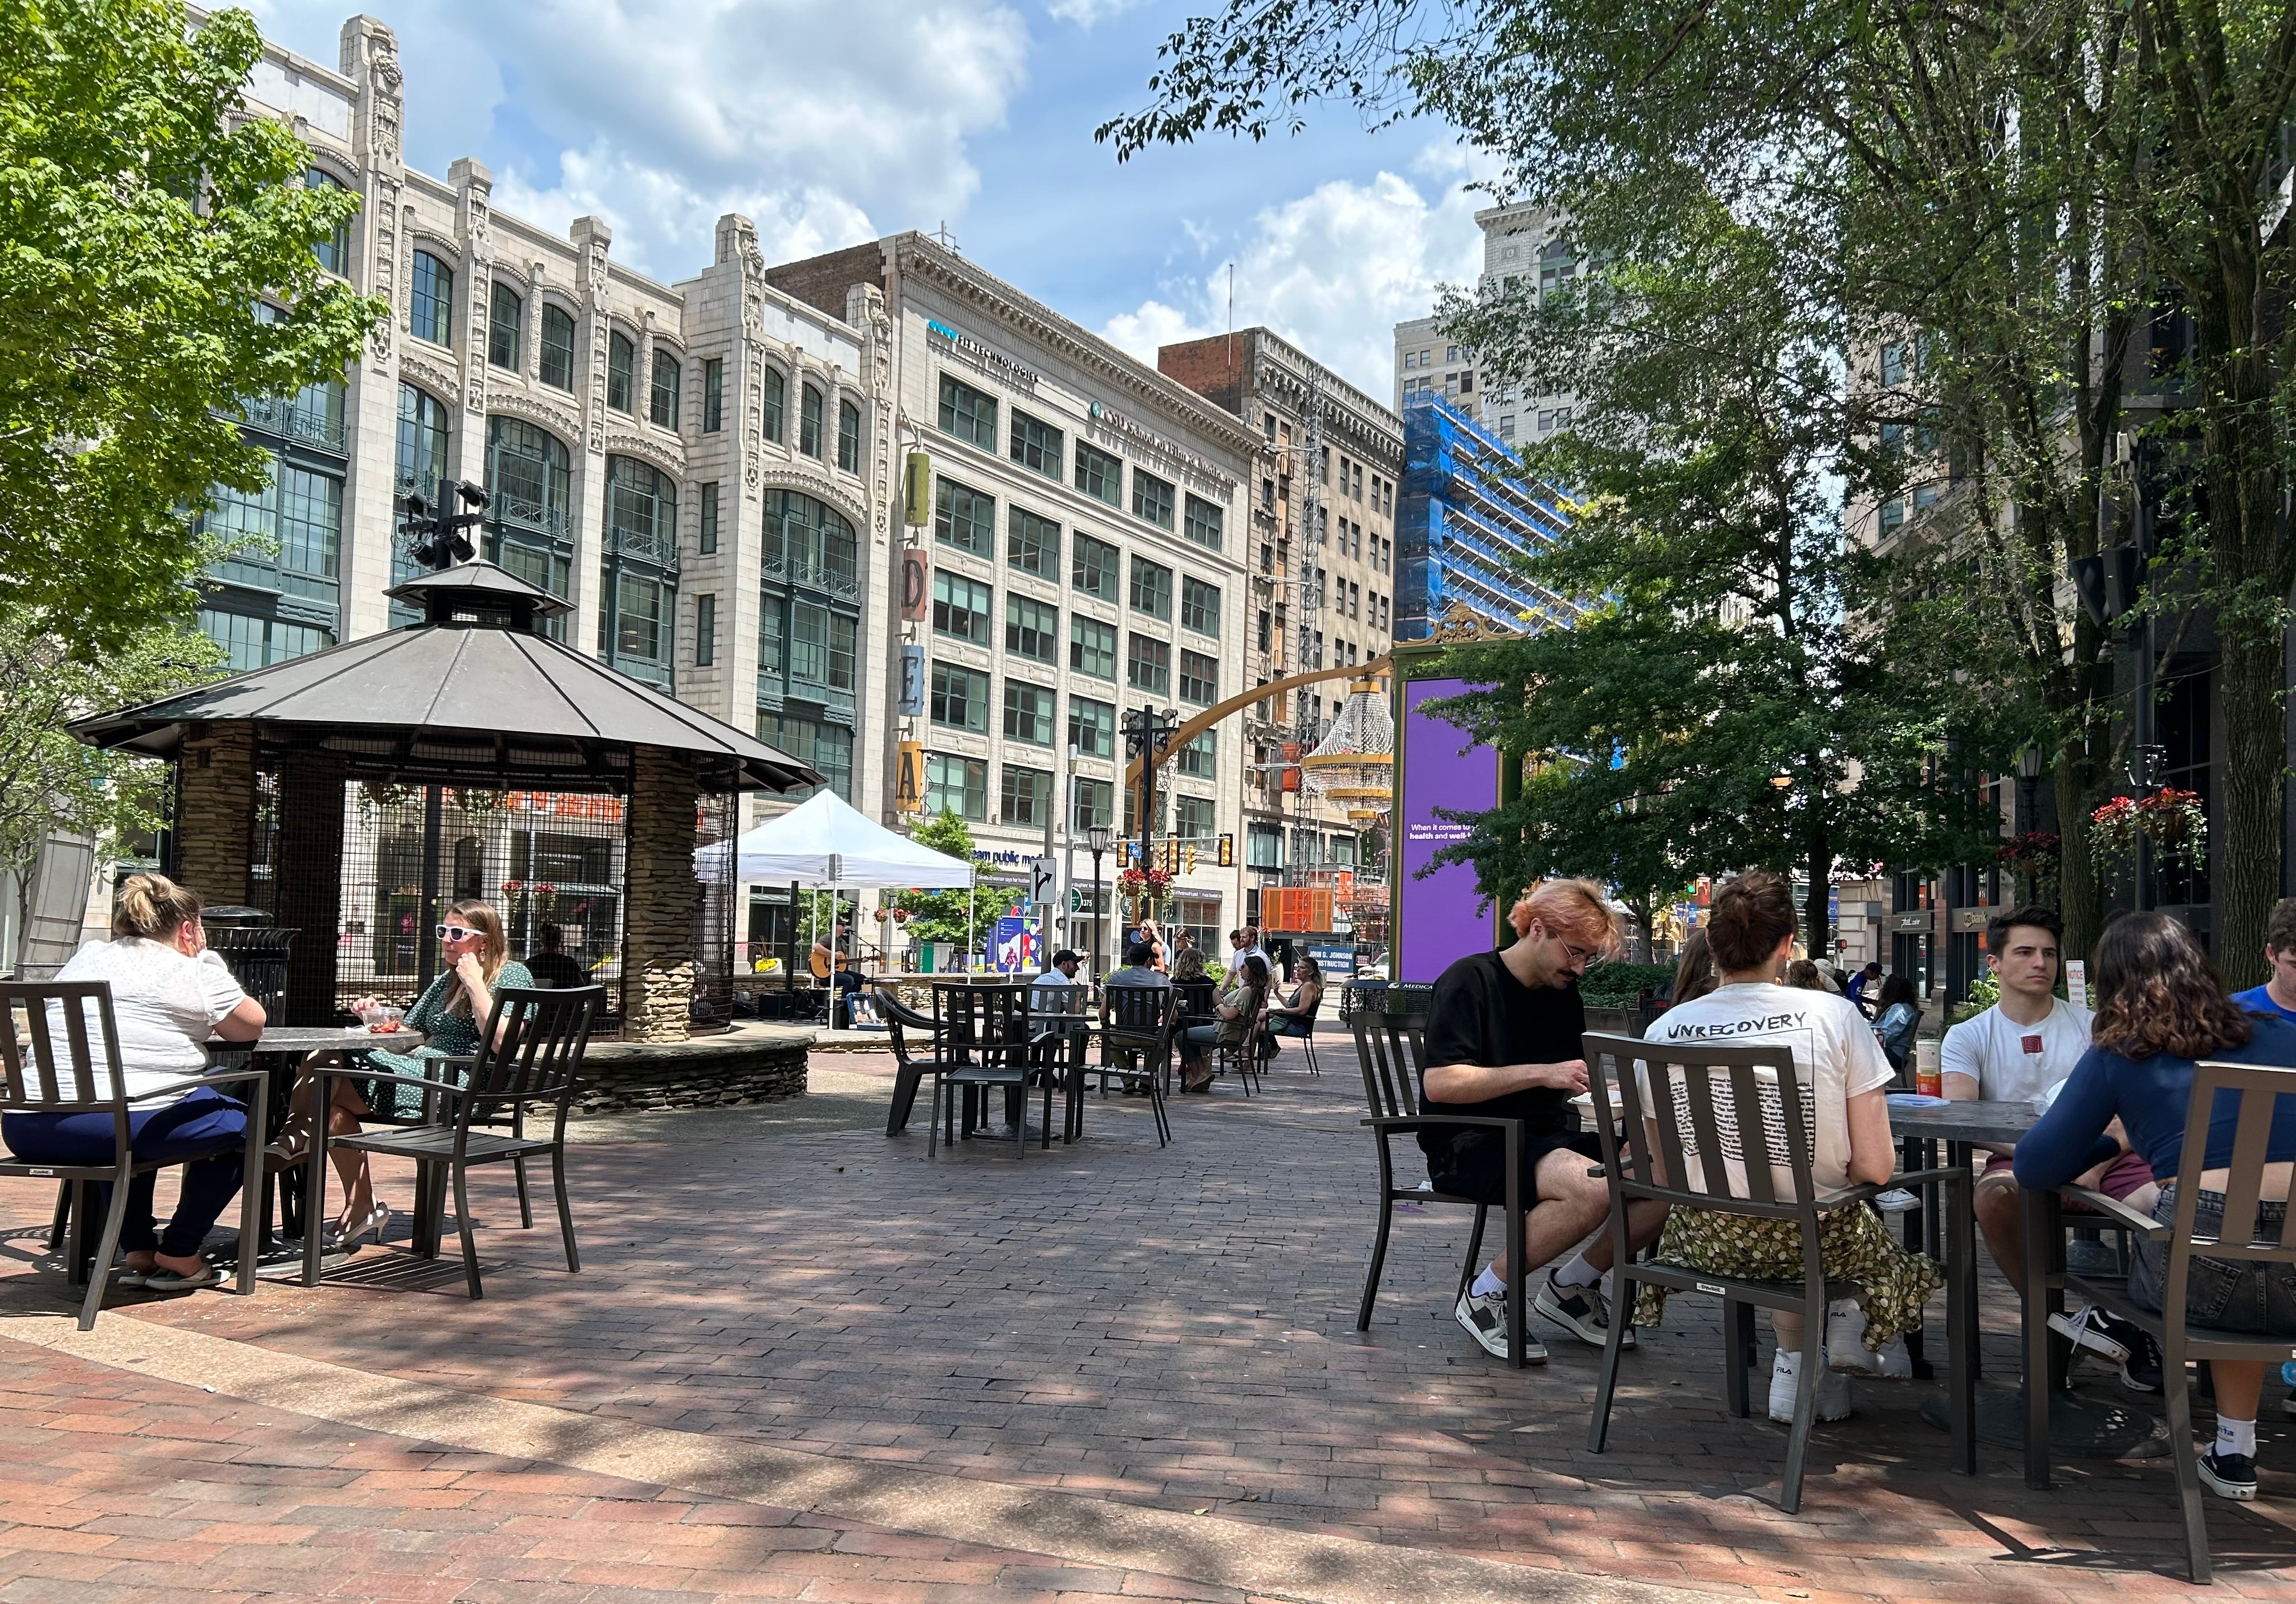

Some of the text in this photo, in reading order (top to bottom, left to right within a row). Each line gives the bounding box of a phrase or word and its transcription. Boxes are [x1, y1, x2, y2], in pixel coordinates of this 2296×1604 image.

[958, 335, 1038, 383] FIT TECHNOLOGIES
[1104, 410, 1238, 487] CSU School of Film & Media Arts
[993, 850, 1019, 864] public
[2067, 970, 2083, 980] NOTICE
[1668, 1012, 1806, 1038] UNRECOVERY
[1776, 1366, 1792, 1375] FILA
